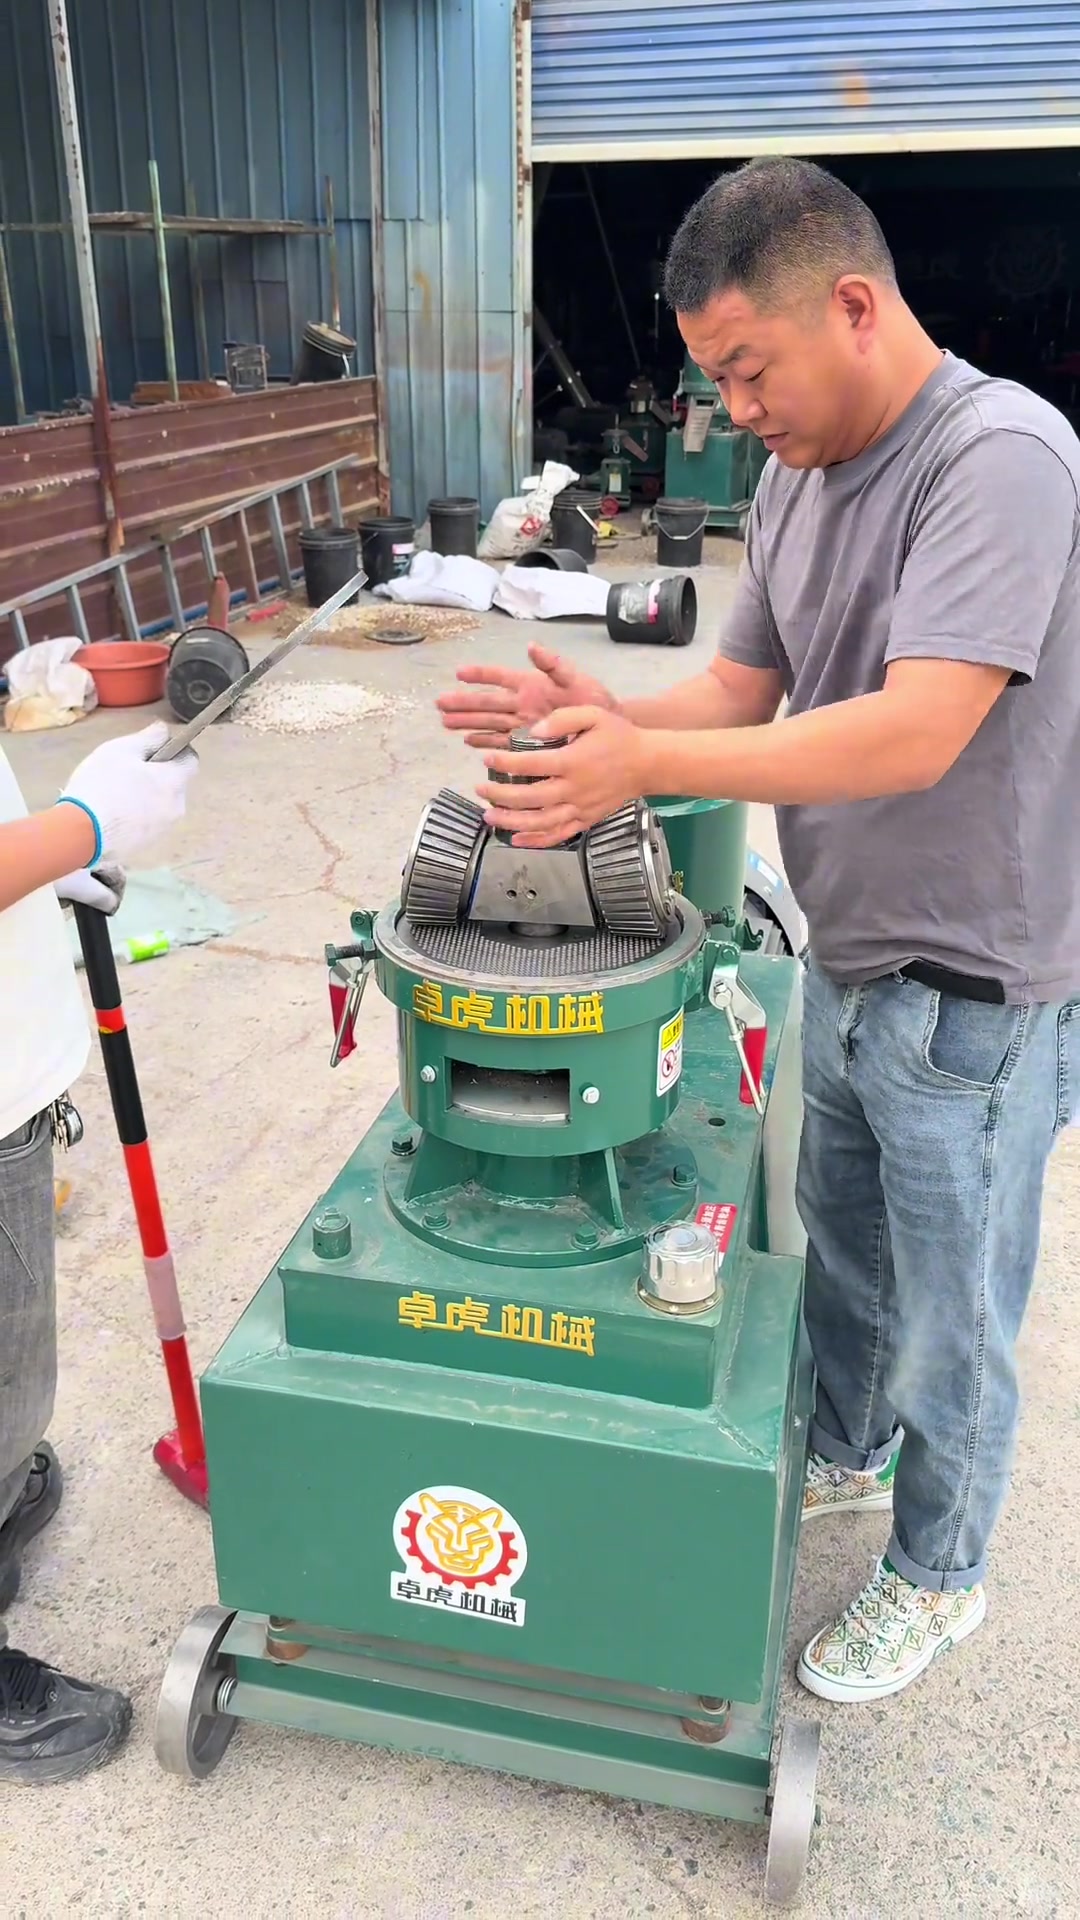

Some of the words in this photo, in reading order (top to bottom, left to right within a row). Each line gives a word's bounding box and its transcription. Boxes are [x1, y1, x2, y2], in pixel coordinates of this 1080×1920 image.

[412, 977, 604, 1034] 卓虎机械
[398, 1290, 595, 1356] 卓虎机械
[397, 1579, 517, 1623] 卓虎机械
